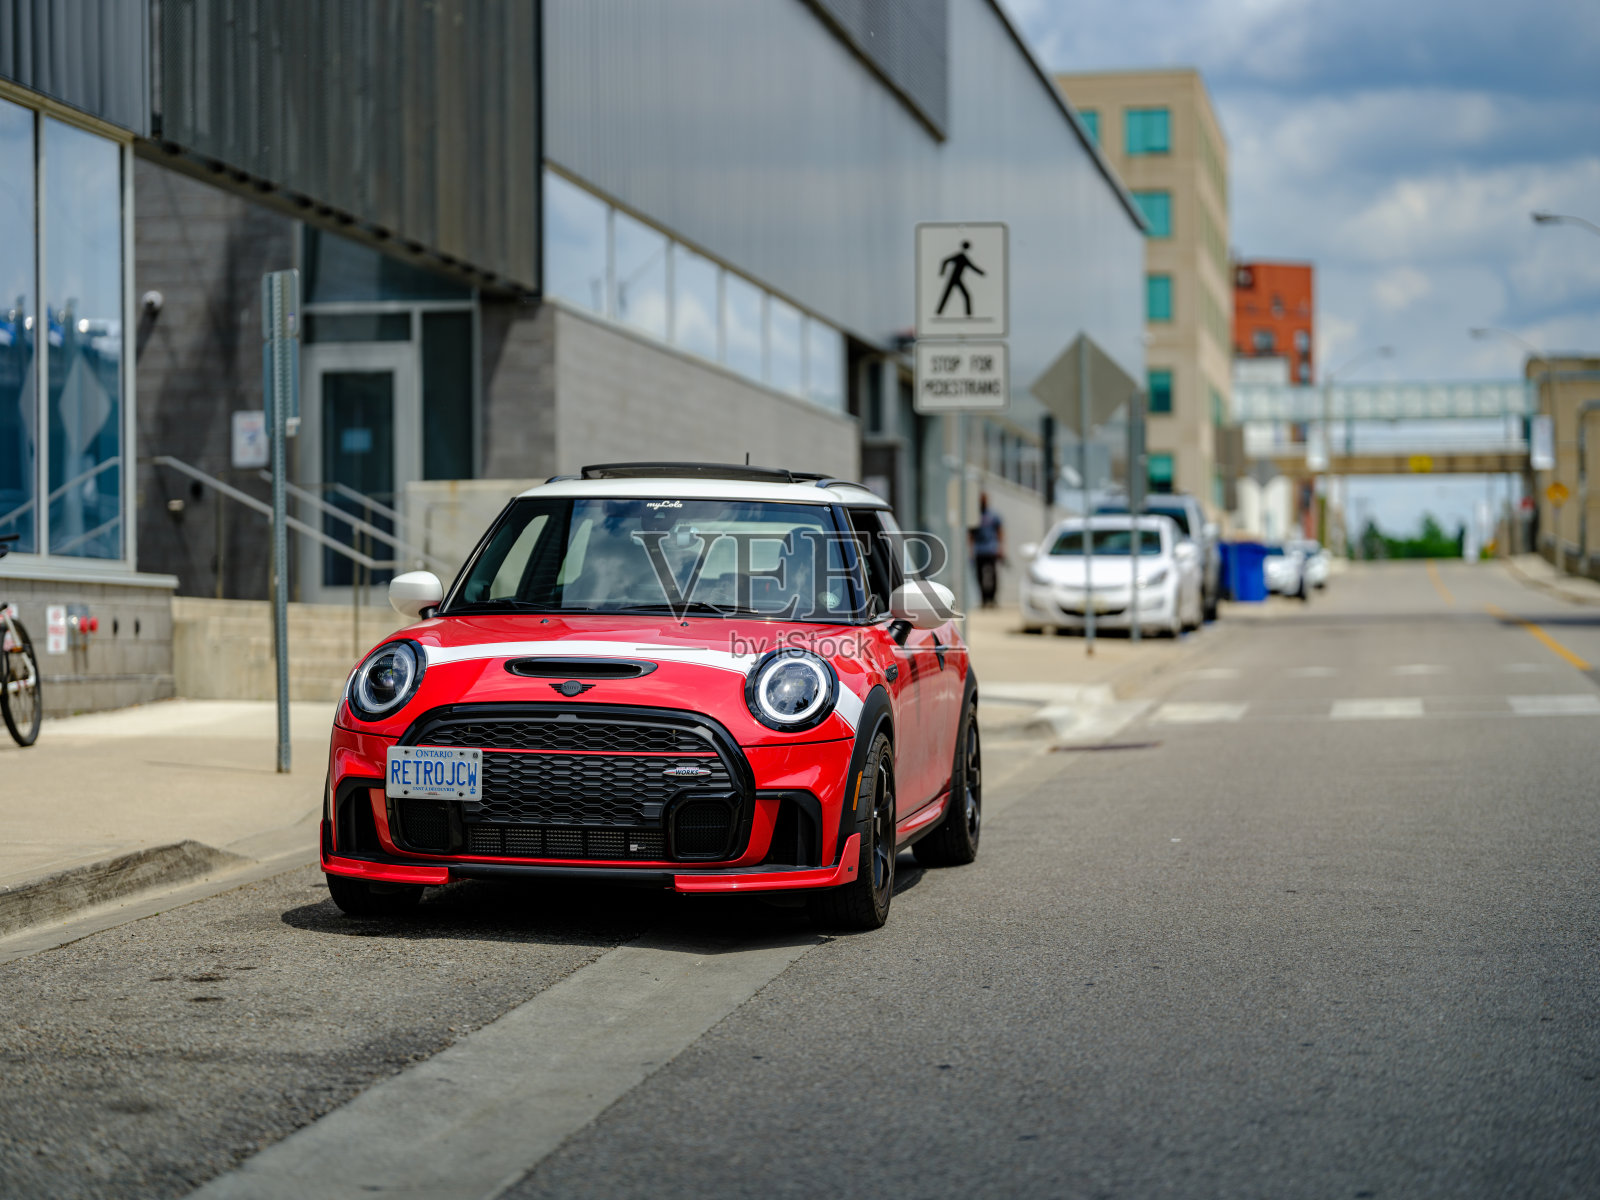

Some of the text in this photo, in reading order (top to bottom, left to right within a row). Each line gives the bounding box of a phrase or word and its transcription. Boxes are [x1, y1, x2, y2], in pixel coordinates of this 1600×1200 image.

[931, 354, 994, 373] STOP FOR
[416, 749, 453, 759] ONTARIO
[391, 760, 478, 787] RETROJCW
